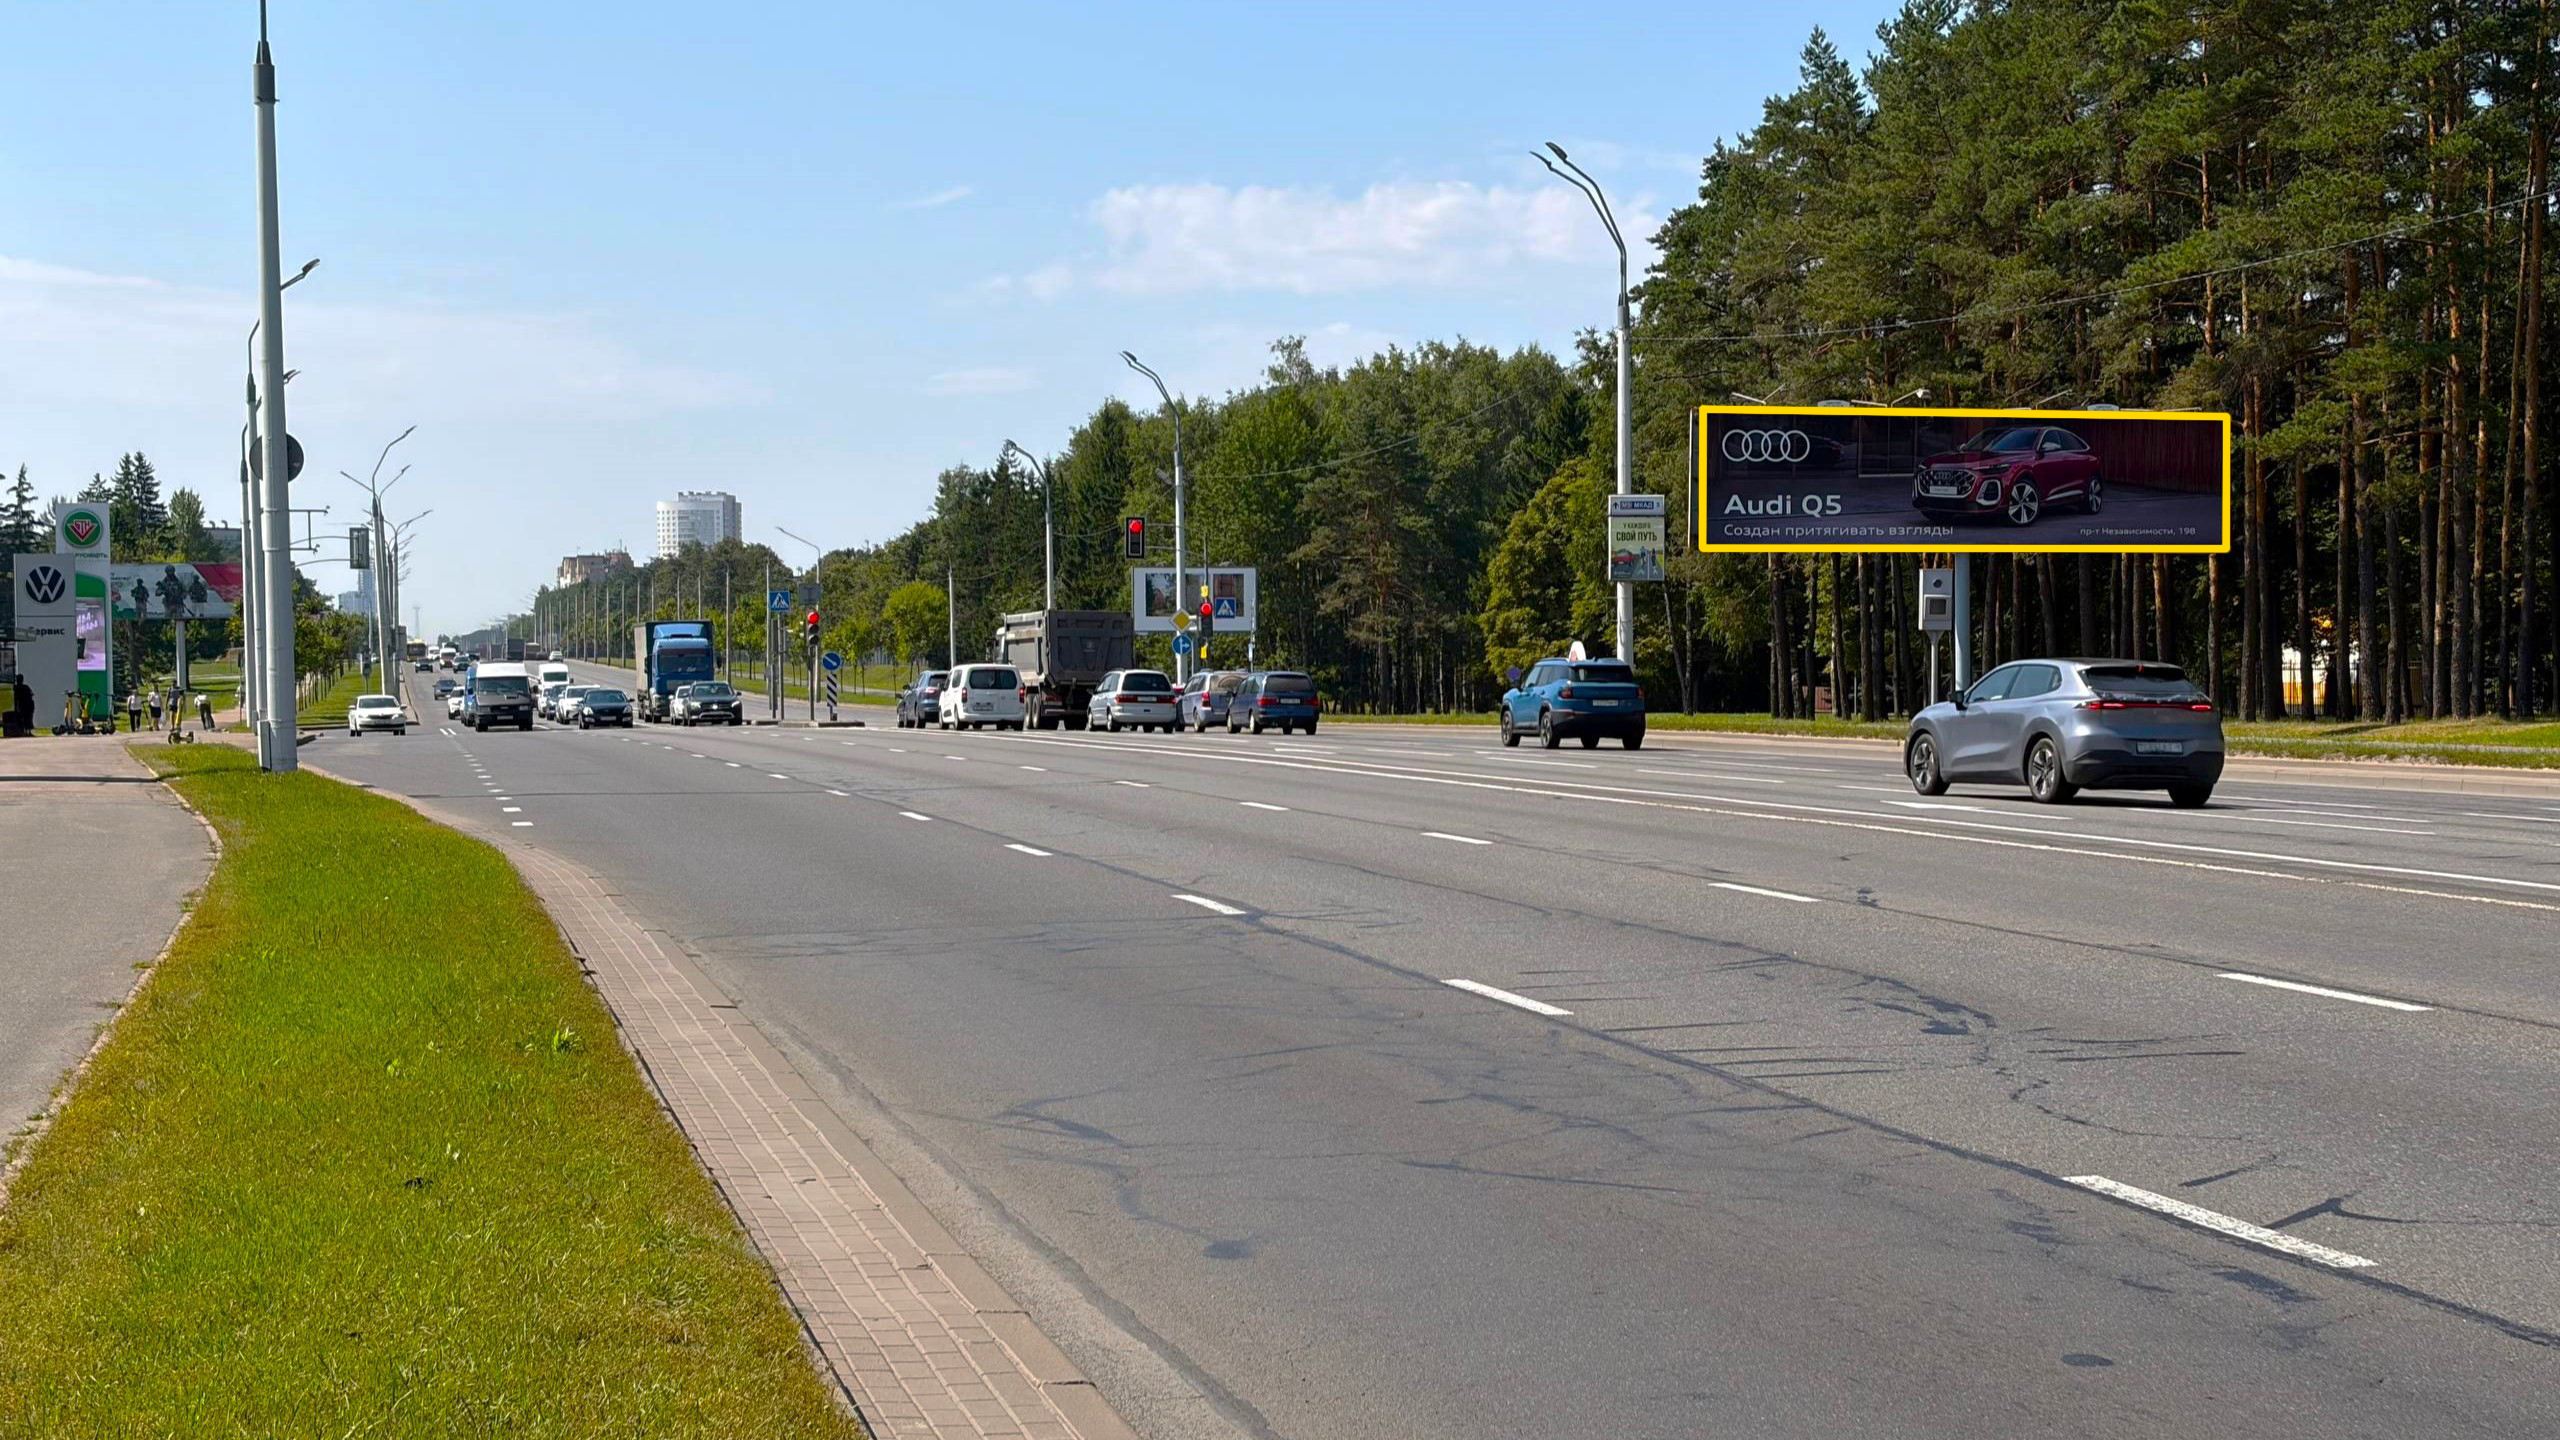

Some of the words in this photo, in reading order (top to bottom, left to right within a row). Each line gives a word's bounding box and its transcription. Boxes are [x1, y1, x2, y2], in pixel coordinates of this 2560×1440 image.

[1723, 494, 1792, 515] Audi
[1801, 494, 1842, 518] Q5
[1616, 530, 1636, 542] СВОЙ
[1637, 531, 1658, 542] ПУТЬ
[1724, 524, 1780, 538] Создан
[1785, 526, 1884, 539] притягивать
[1889, 525, 1953, 537] взгляды
[2080, 528, 2099, 536] пр-т
[2102, 527, 2176, 536] Независимости,
